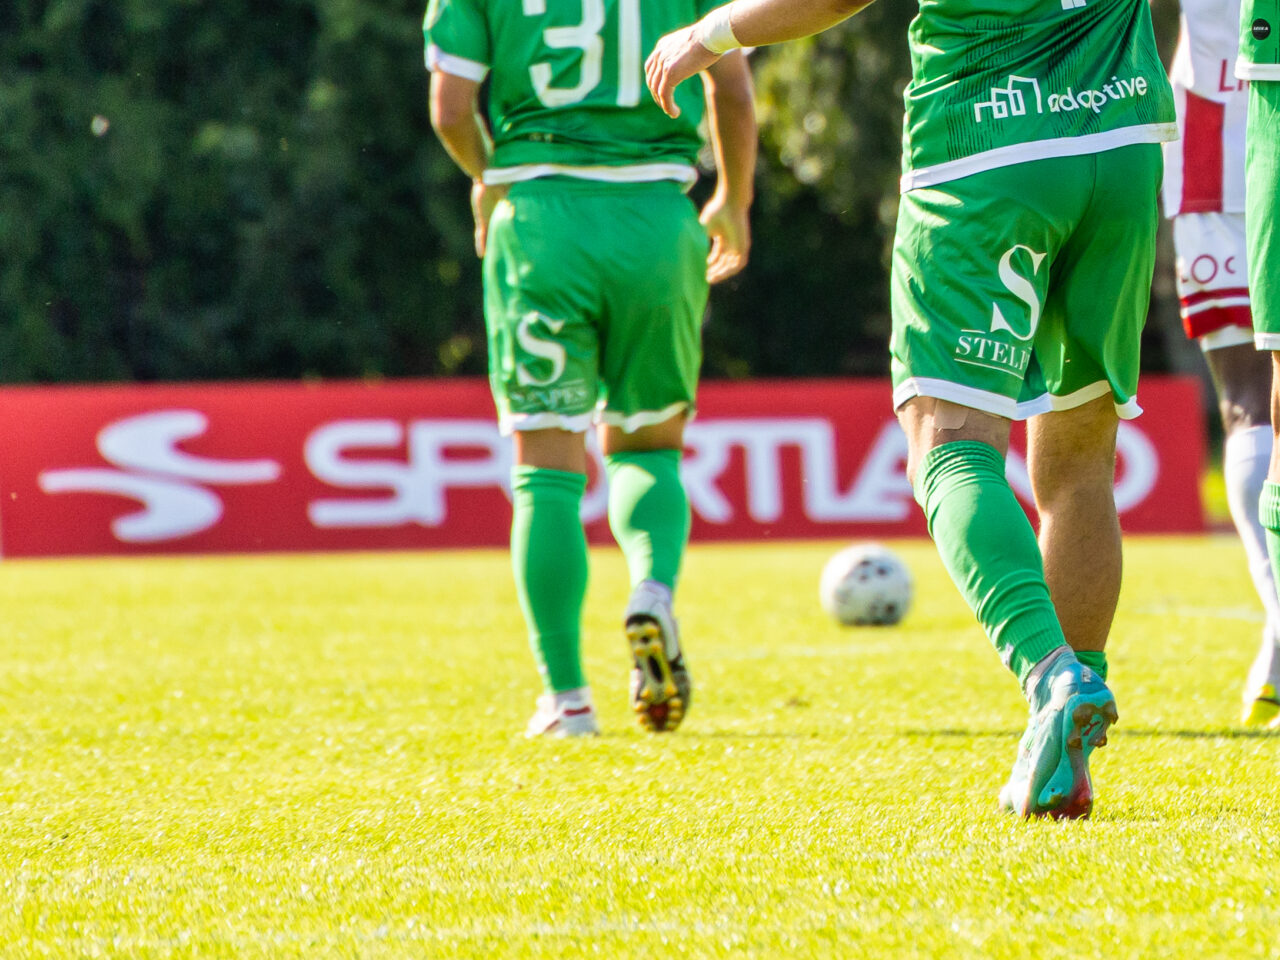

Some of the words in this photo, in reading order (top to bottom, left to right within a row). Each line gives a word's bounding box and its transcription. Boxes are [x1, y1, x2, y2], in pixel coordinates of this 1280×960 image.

[1047, 76, 1147, 113] adaptive
[990, 244, 1047, 341] S
[516, 309, 566, 387] S
